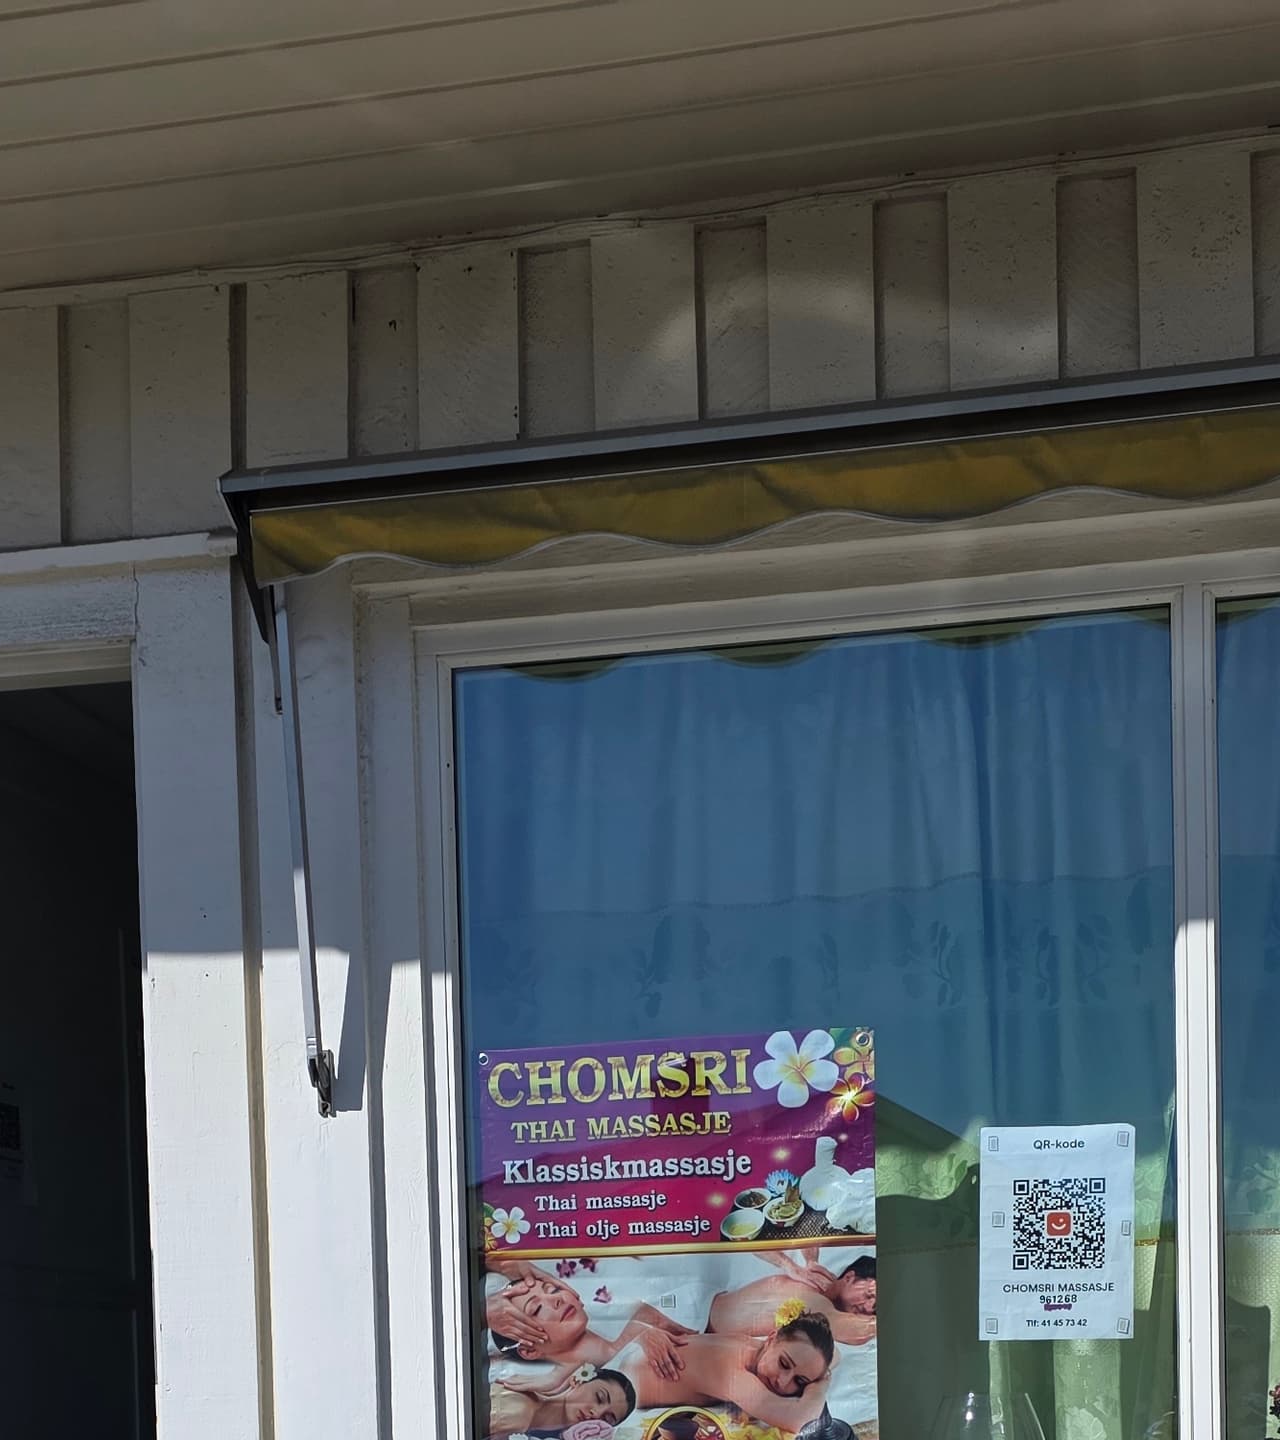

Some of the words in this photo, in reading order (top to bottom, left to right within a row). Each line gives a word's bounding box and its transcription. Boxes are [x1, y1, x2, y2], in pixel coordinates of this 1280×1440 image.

[487, 1048, 753, 1108] CHOMSRI
[510, 1118, 577, 1144] THAI
[587, 1111, 732, 1141] MASSASJE
[1033, 1138, 1085, 1150] QR-kode
[502, 1149, 752, 1184] Klassiskmassasje
[534, 1193, 577, 1212] Thai
[585, 1190, 667, 1211] massasje
[534, 1221, 577, 1239] Thai
[585, 1219, 620, 1240] olje
[627, 1215, 711, 1237] massasje
[1002, 1283, 1055, 1293] CHOMSRI
[1058, 1282, 1115, 1292] MASSASJE
[1025, 1319, 1039, 1327] Tlf:
[1041, 1319, 1051, 1327] 41
[1053, 1319, 1064, 1327] 45
[1077, 1318, 1088, 1326] 42
